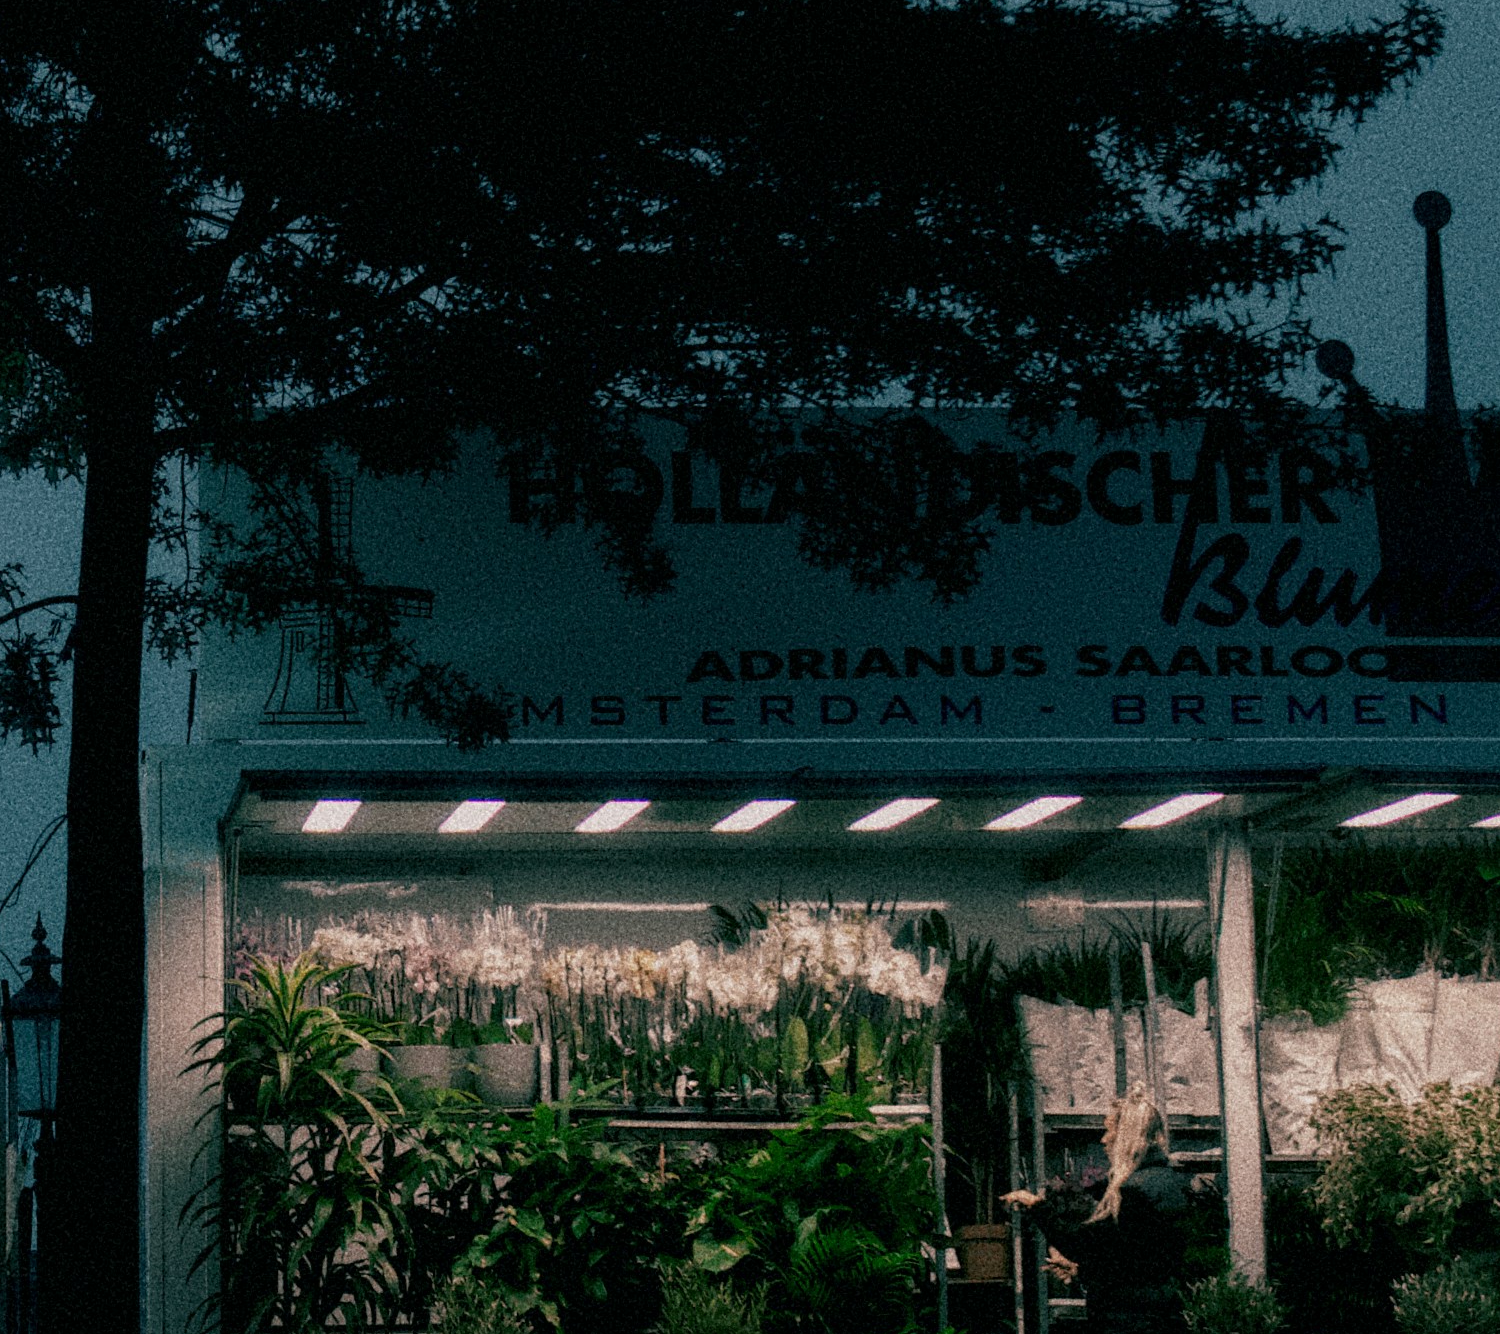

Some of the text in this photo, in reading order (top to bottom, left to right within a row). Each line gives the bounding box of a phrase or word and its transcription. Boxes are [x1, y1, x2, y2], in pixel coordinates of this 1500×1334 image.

[685, 646, 1047, 683] ADRIANUS
[466, 695, 984, 727] MSTERDAM
[1112, 693, 1449, 727] BREMEN
